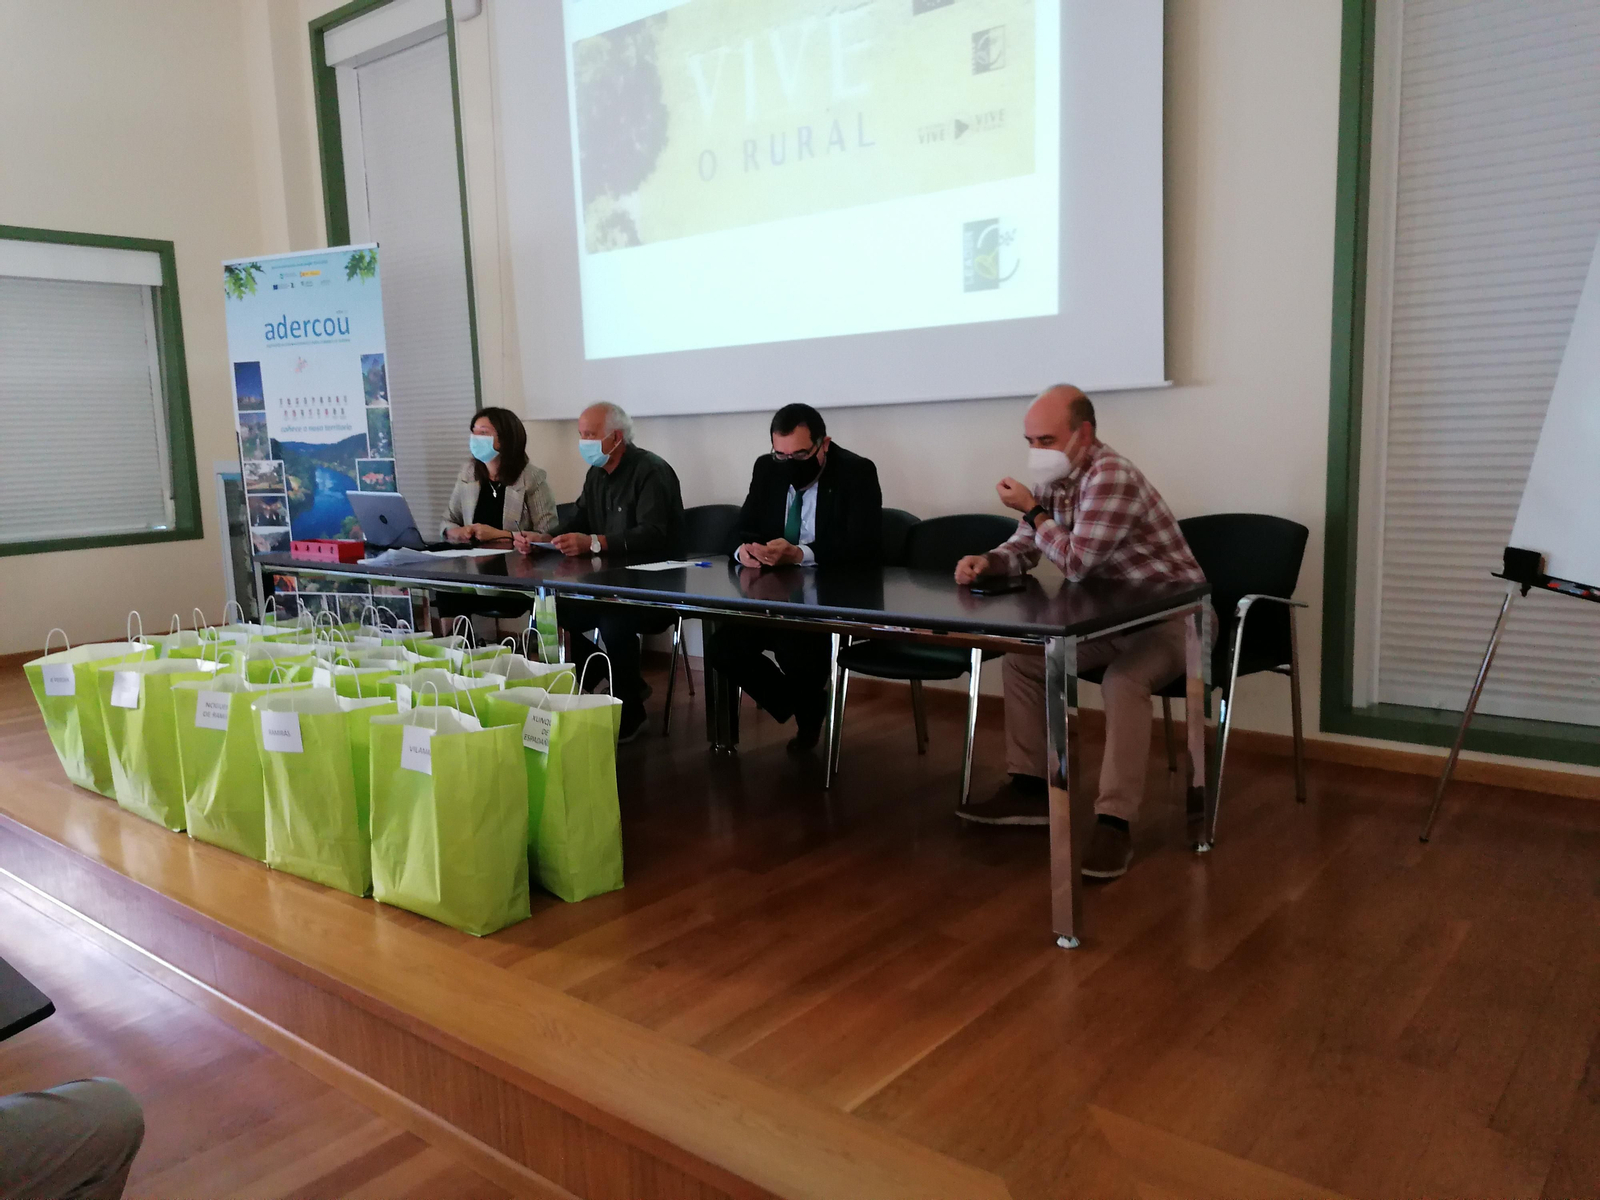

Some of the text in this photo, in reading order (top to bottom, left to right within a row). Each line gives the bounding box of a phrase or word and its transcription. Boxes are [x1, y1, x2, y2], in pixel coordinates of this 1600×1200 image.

[686, 10, 874, 127] VIVE
[698, 112, 876, 182] O RURAL
[264, 314, 350, 341] adercou
